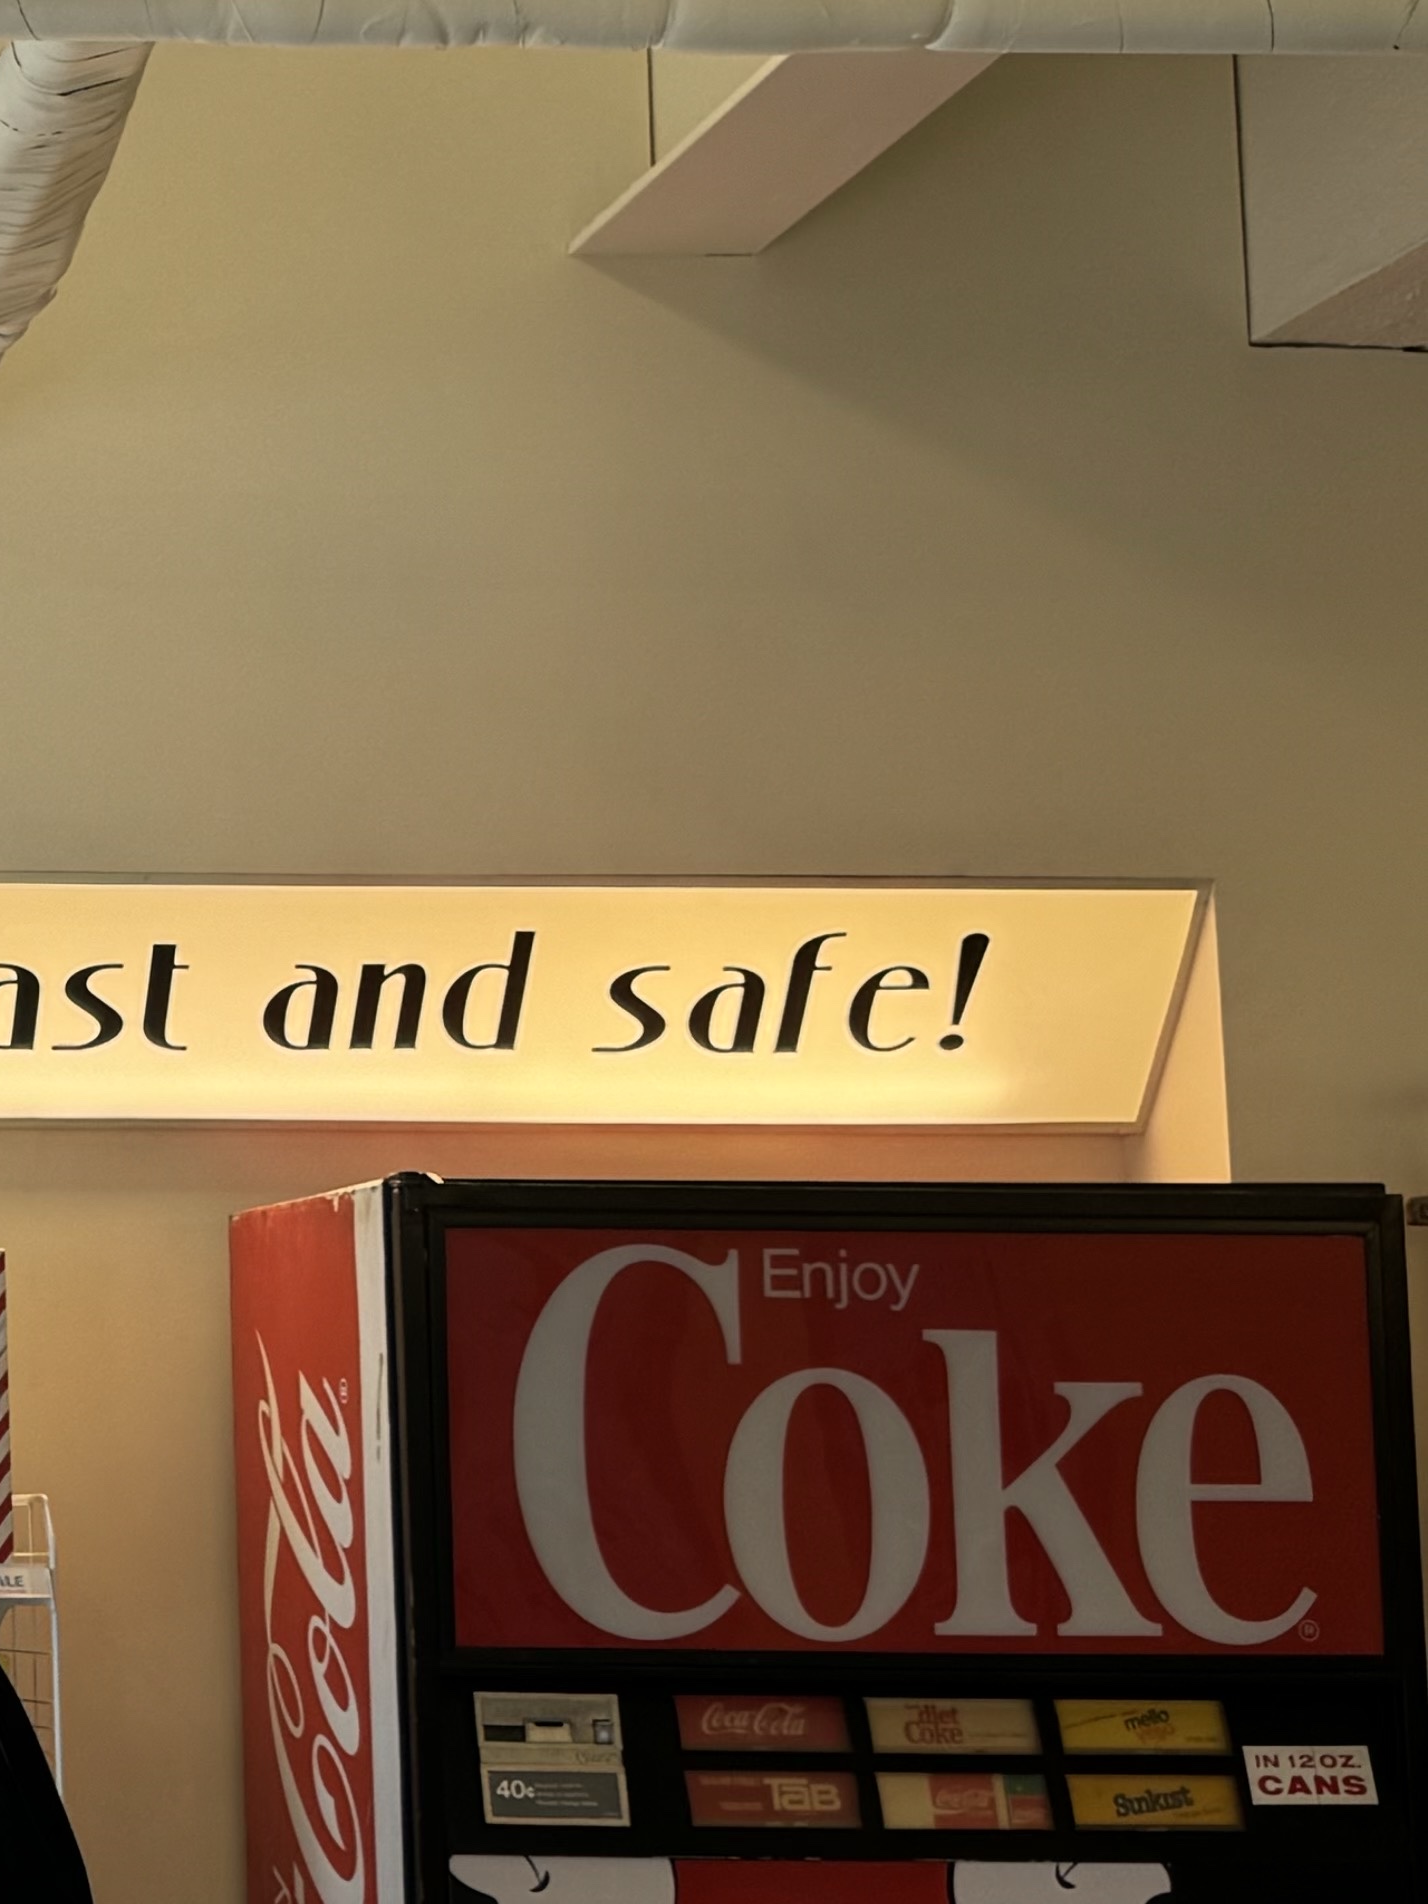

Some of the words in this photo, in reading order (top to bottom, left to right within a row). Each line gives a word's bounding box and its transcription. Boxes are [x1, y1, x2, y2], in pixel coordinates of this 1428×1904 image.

[261, 929, 536, 1053] and
[591, 931, 991, 1055] safe!
[760, 1246, 920, 1310] Enjoy
[512, 1242, 1318, 1646] Coke
[917, 1704, 959, 1725] diet
[904, 1721, 963, 1745] Coke
[1254, 1754, 1280, 1769] IN
[1257, 1774, 1367, 1796] CANS
